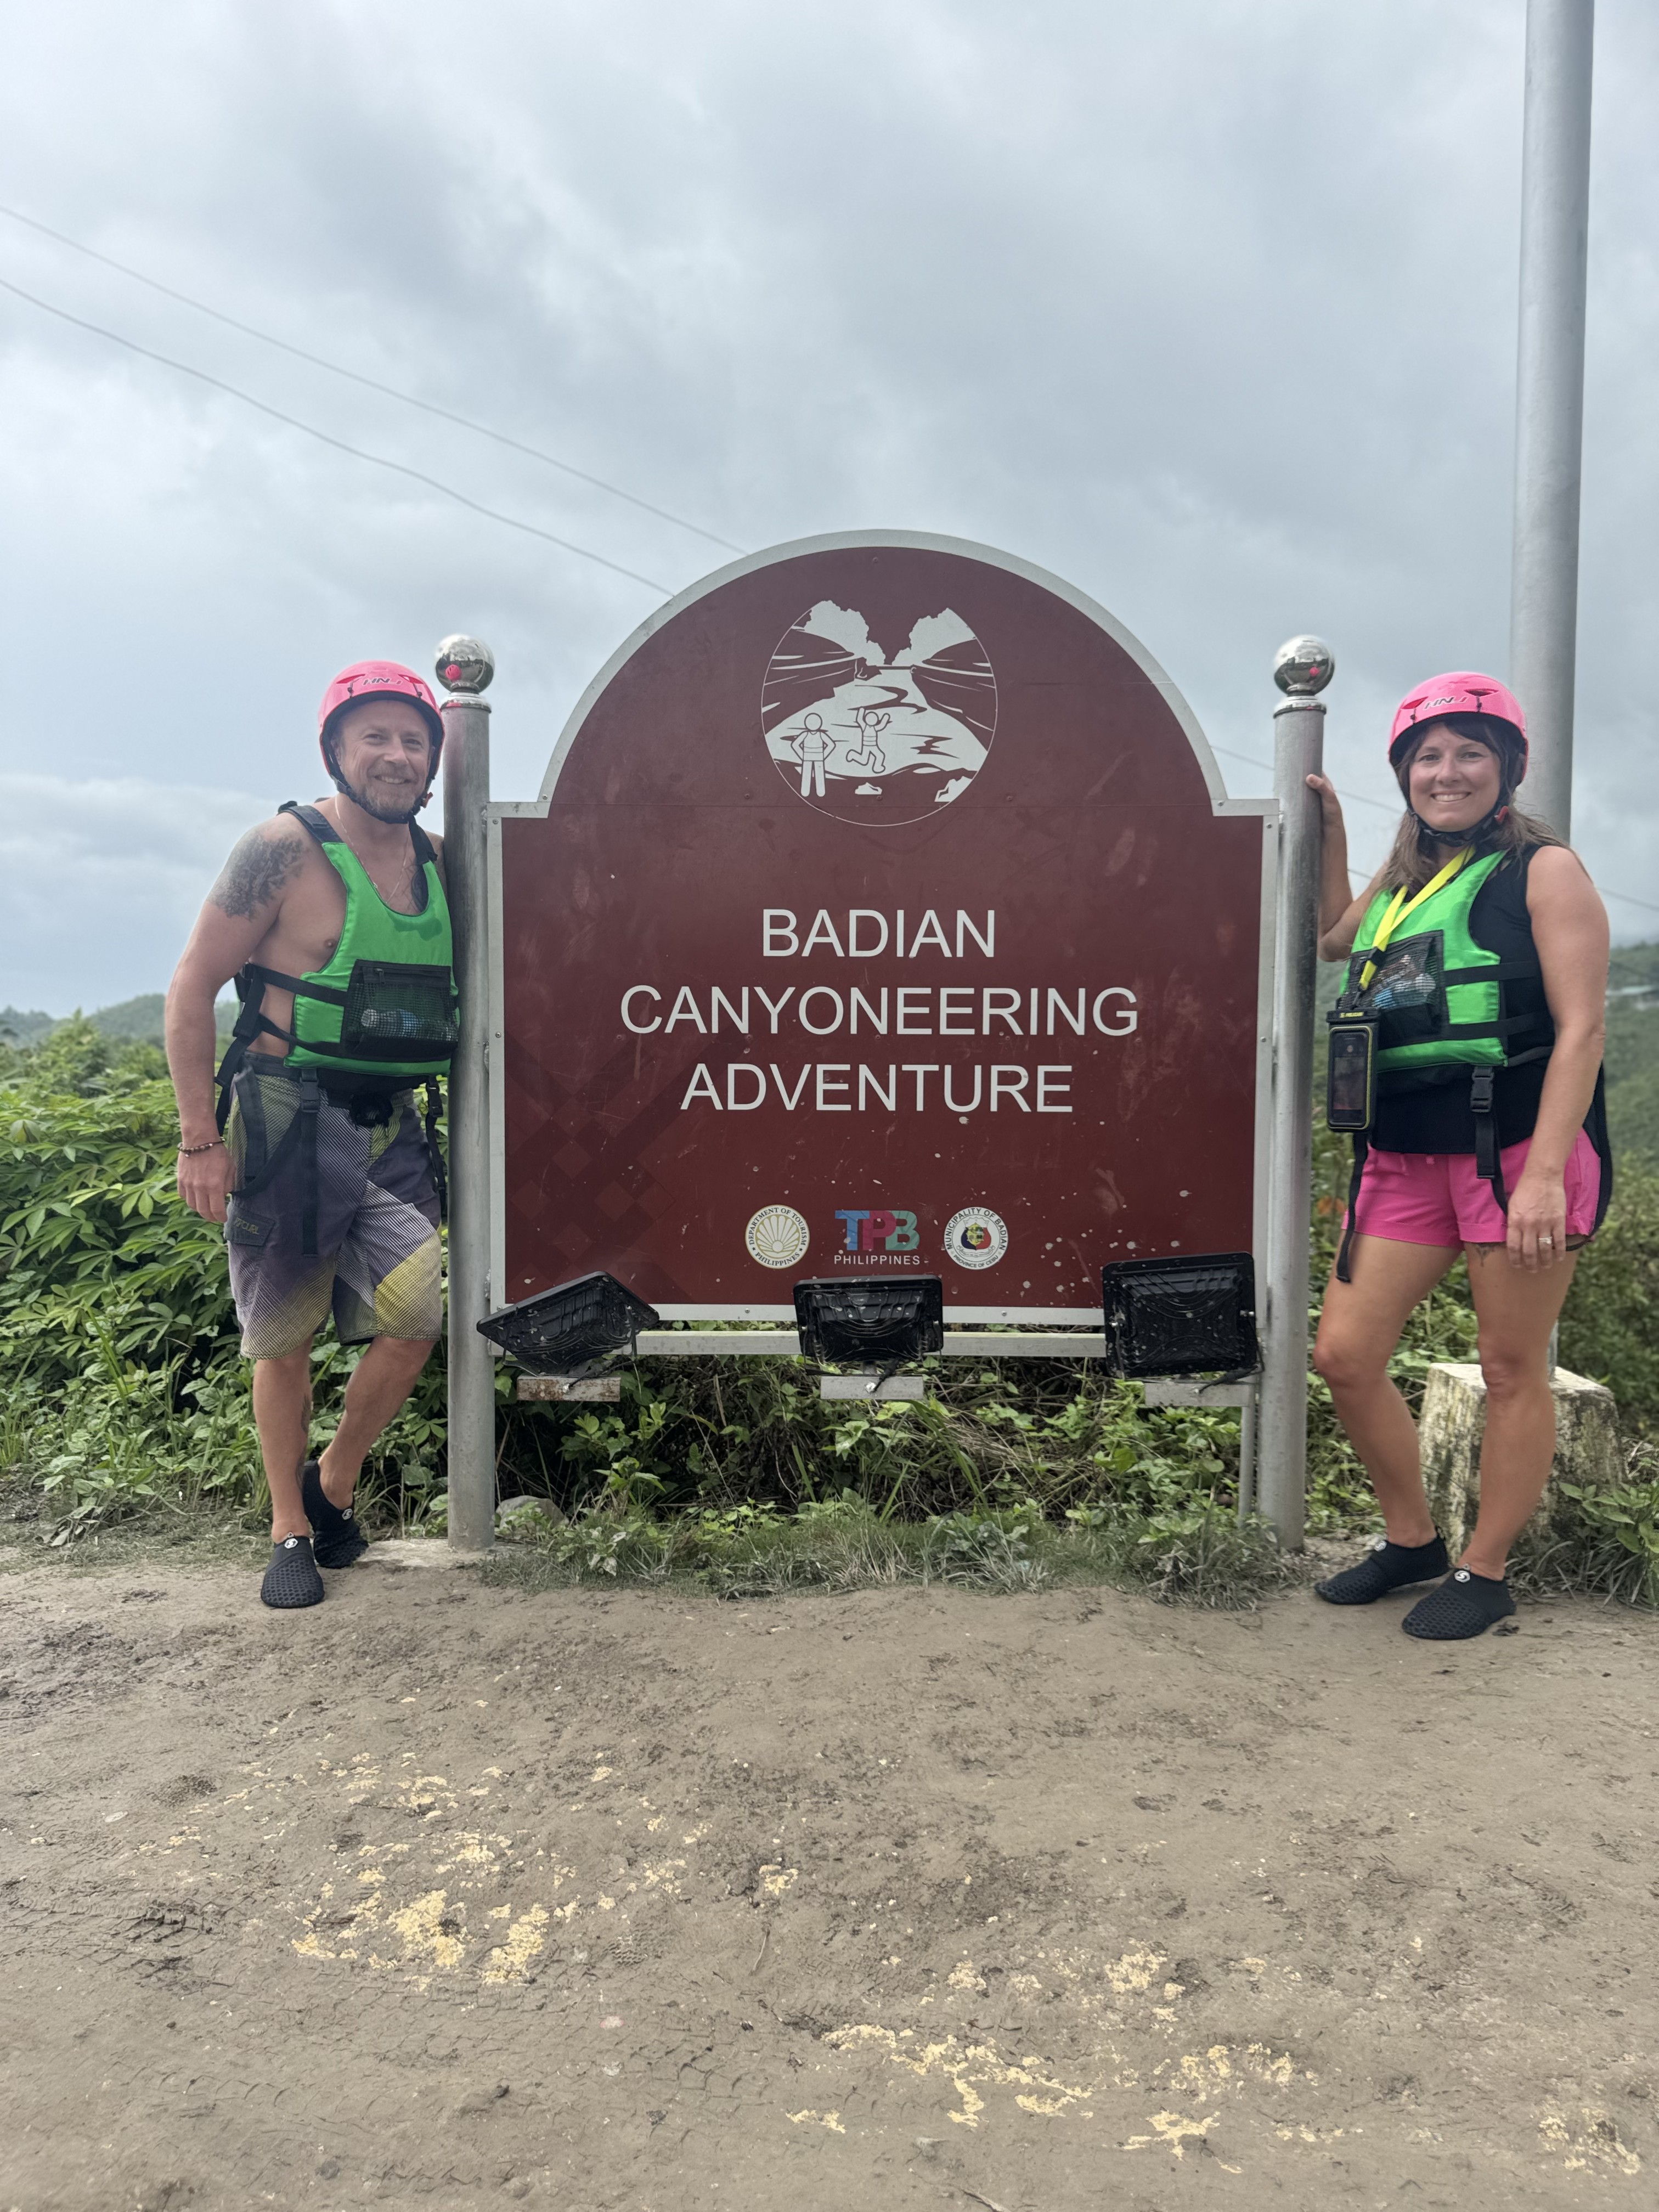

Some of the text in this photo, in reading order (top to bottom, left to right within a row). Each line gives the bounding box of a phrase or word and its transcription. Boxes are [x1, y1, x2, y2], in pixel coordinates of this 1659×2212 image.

[762, 909, 995, 958] BADIAN
[620, 985, 1138, 1036] CANYONEERING
[680, 1063, 1073, 1113] ADVENTURE
[749, 1207, 779, 1245] DEPARTMENT
[792, 1212, 807, 1246] TOURISM
[835, 1210, 920, 1251] TPB
[945, 1208, 981, 1250] MUNICIPALITY
[995, 1218, 1007, 1251] BADIAN
[755, 1252, 800, 1266] PHILIPPINES
[834, 1255, 920, 1265] PHILIPPINES
[953, 1254, 977, 1268] PROVINCE
[985, 1255, 998, 1266] CEBU
